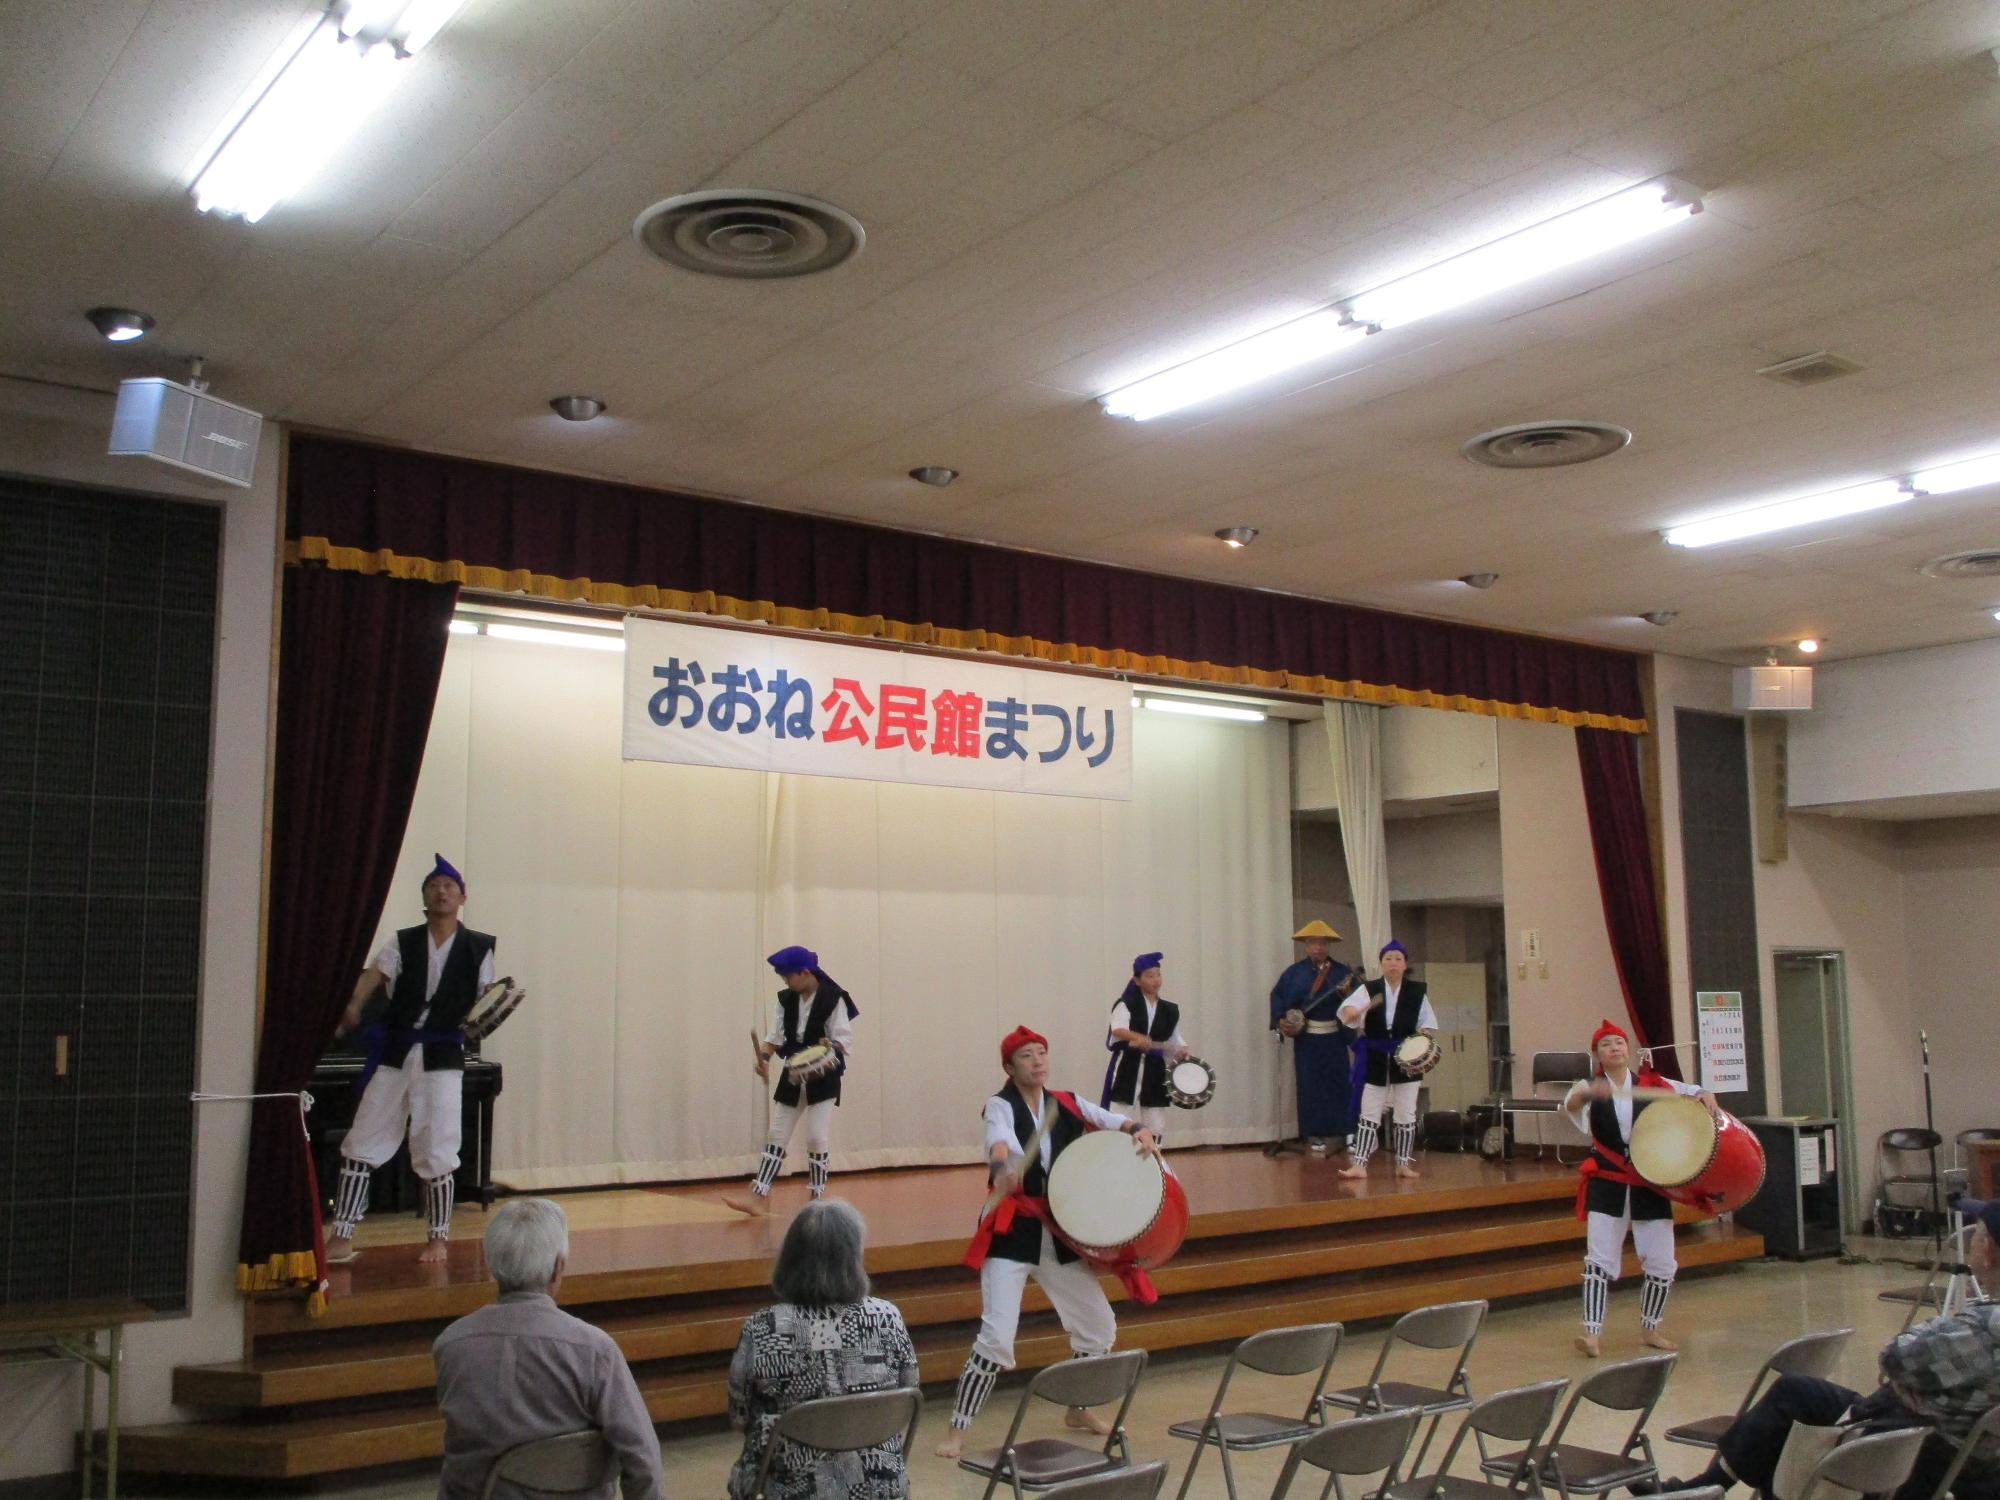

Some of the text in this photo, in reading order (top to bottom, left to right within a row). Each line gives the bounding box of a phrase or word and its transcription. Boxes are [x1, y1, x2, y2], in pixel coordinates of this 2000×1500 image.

[647, 656, 1115, 768] おおね公民館まつり
